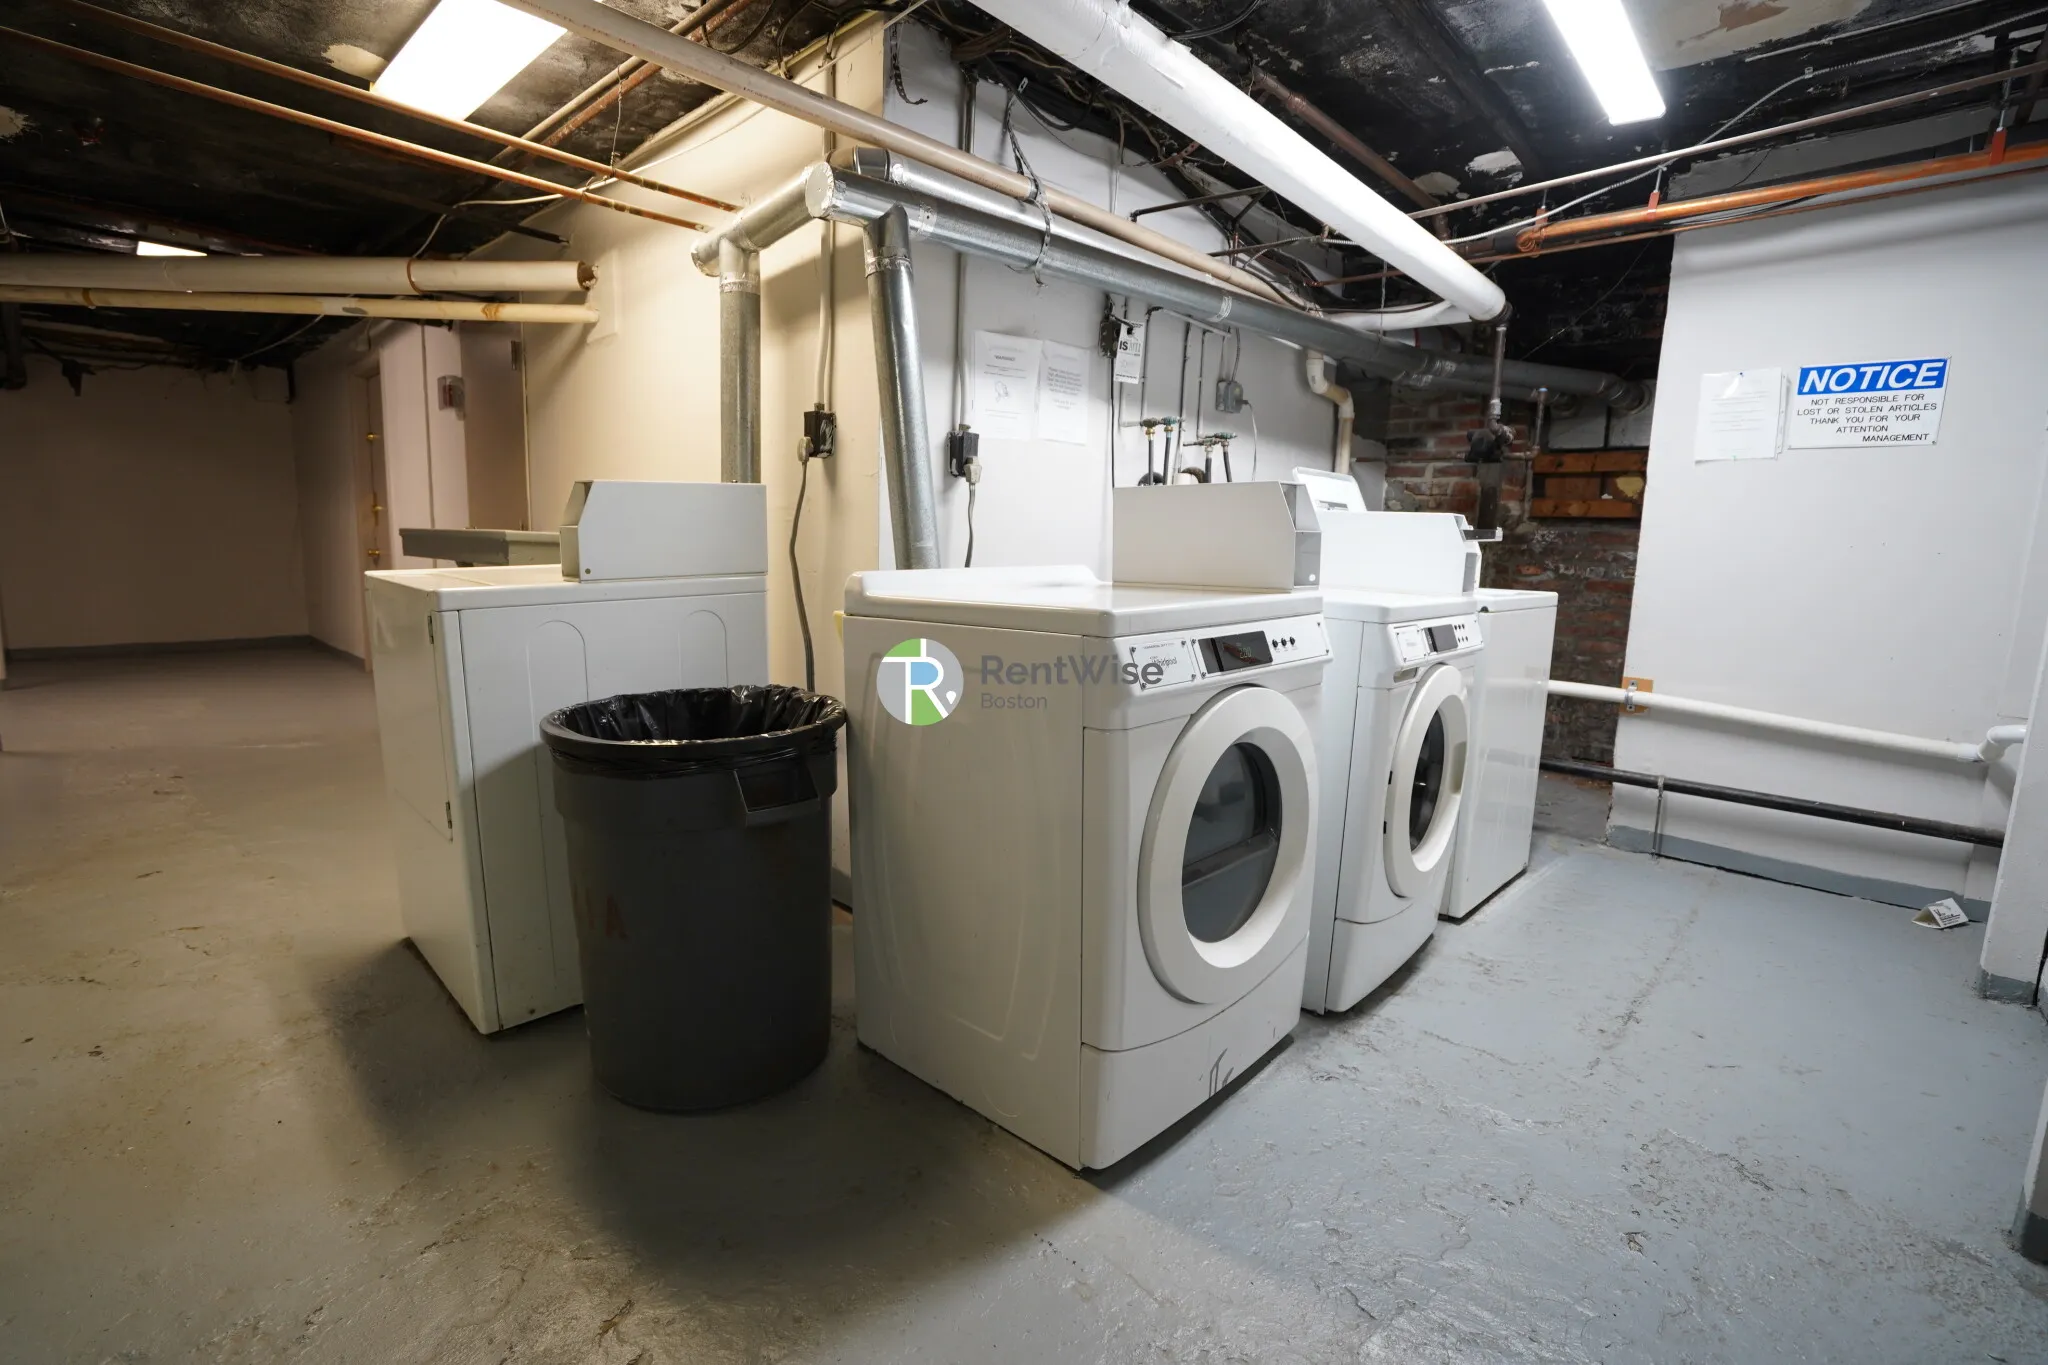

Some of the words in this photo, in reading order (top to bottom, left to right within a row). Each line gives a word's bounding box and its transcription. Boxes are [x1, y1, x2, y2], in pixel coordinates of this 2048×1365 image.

[1802, 362, 1945, 393] NOTICE
[1811, 398, 1829, 406] NOT
[1834, 394, 1899, 405] RESPONSIBLE
[1904, 393, 1925, 401] FOR
[1797, 408, 1821, 416] LOST
[1827, 407, 1840, 415] OR
[1845, 405, 1883, 414] STOLEN
[1888, 403, 1937, 412] ARTICLES
[1810, 417, 1839, 425] THANK
[1845, 416, 1864, 424] YOU
[1868, 415, 1888, 423] FOR
[1894, 414, 1921, 422] YOUR
[1836, 425, 1889, 433] ATTENTION
[1862, 433, 1930, 443] MANAGEMENT
